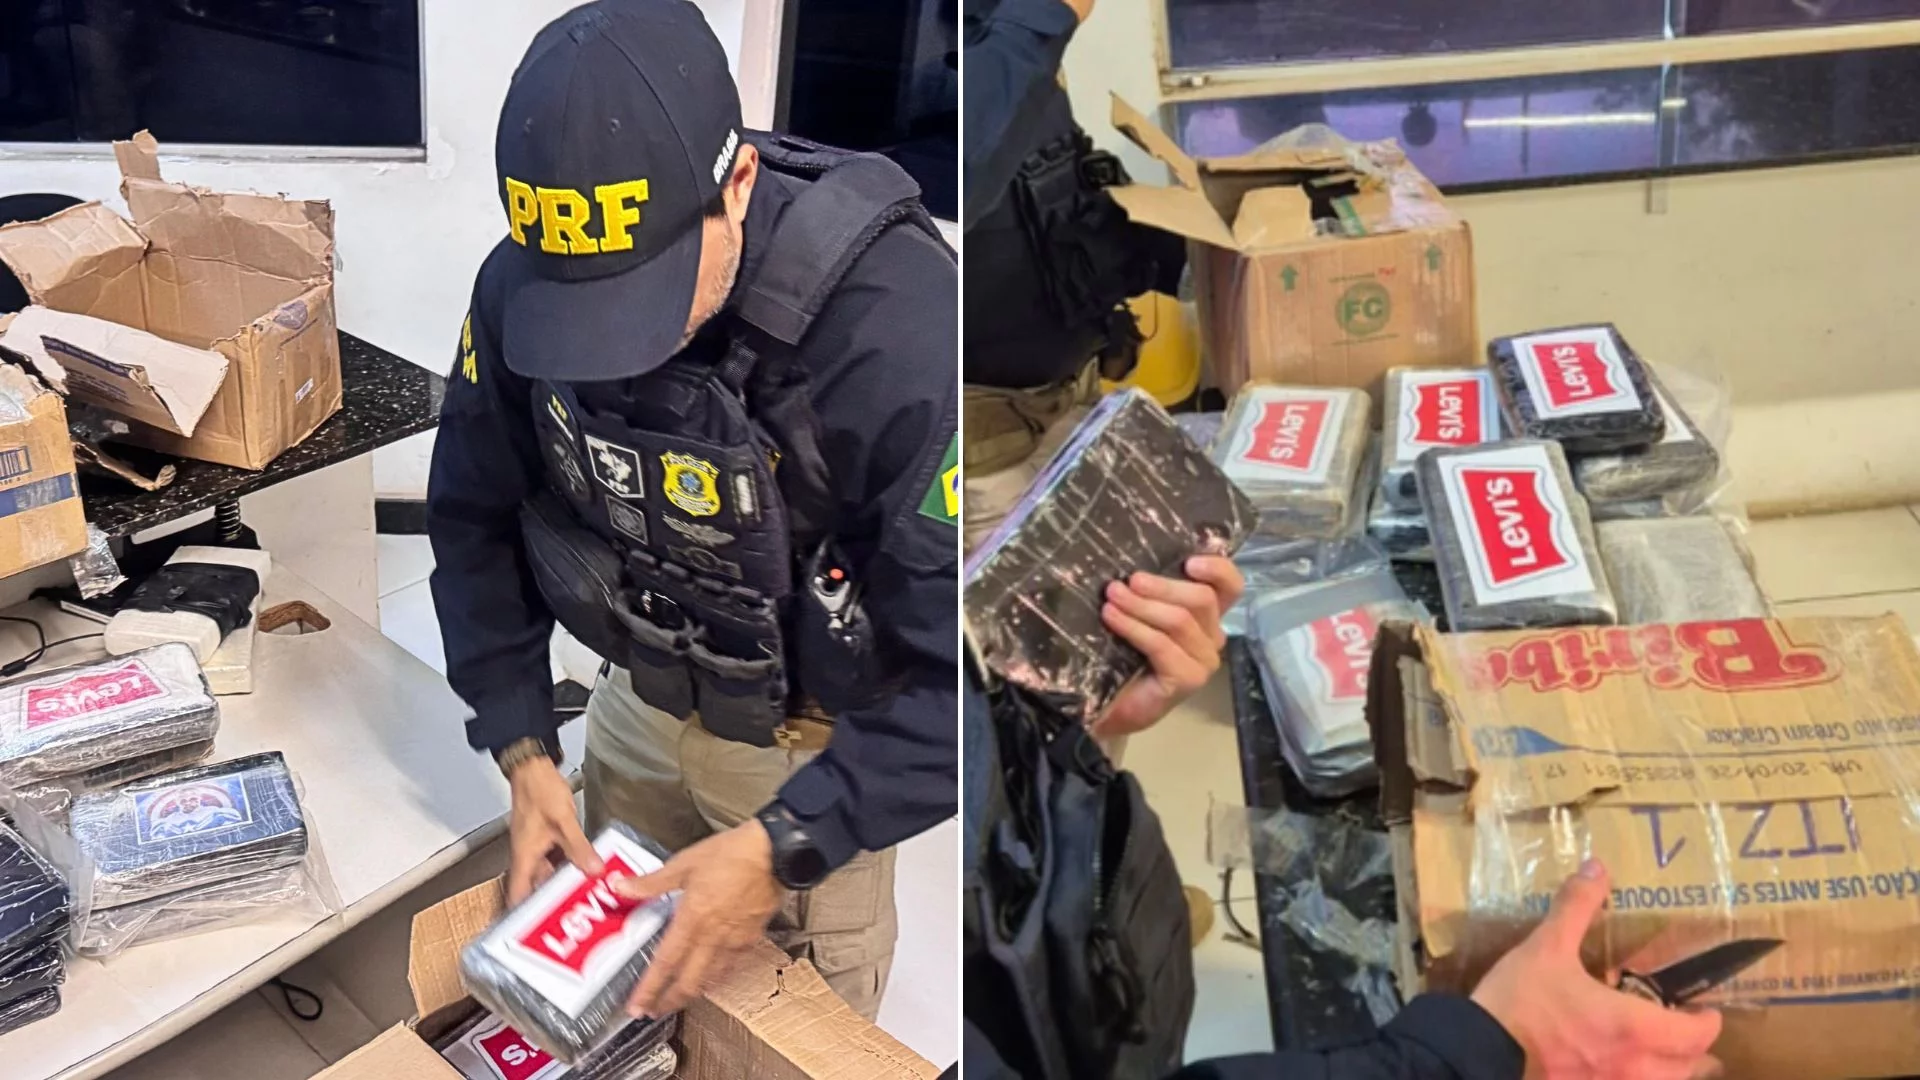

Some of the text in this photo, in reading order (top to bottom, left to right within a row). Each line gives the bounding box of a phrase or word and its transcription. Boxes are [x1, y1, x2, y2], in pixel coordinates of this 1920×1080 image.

[505, 176, 649, 255] PRF
[1342, 296, 1384, 324] FC
[1551, 345, 1594, 399] Levi's
[1268, 403, 1310, 460] Levi's
[1438, 385, 1464, 440] Levi's
[1485, 476, 1539, 568] Levi's
[1612, 884, 1708, 909] ESTOQUE
[1753, 878, 1820, 903] ANTES
[1825, 873, 1868, 899] USE
